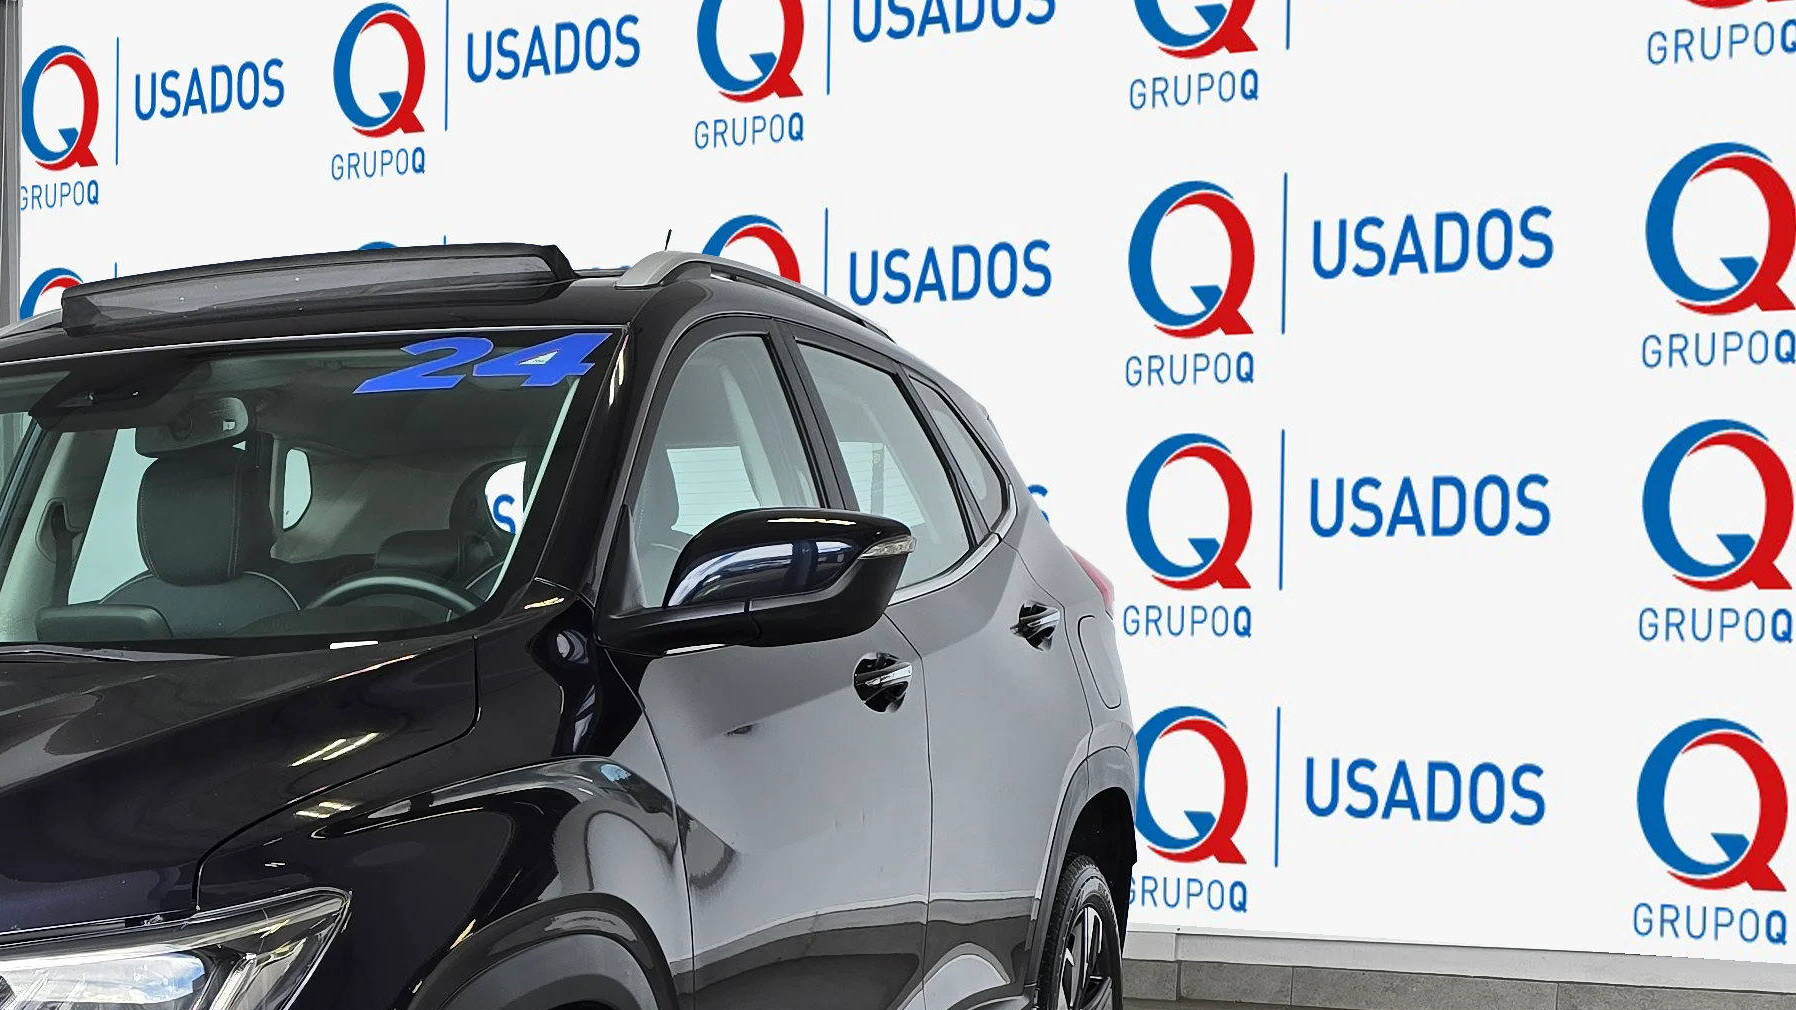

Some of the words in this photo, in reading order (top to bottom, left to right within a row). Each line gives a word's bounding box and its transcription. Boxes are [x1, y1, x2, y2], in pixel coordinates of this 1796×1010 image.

[466, 13, 642, 84] USADOS
[1646, 17, 1796, 65] GRUPOQ
[134, 56, 286, 122] USADOS
[1129, 67, 1260, 111] GRUPOQ
[693, 111, 805, 151] GRUPOQ
[331, 145, 426, 182] GRUPOQ
[1311, 204, 1554, 281] USADOS
[848, 238, 1053, 307] USADOS
[353, 333, 613, 394] 24
[1125, 350, 1255, 387] GRUPOQ
[1640, 328, 1796, 369] GRUPOQ
[1309, 472, 1552, 539] USADOS
[1122, 604, 1253, 638] GRUPOQ
[1638, 606, 1794, 644] GRUPOQ
[1304, 756, 1547, 827] USADOS
[1632, 901, 1788, 947] GRUPOQ
